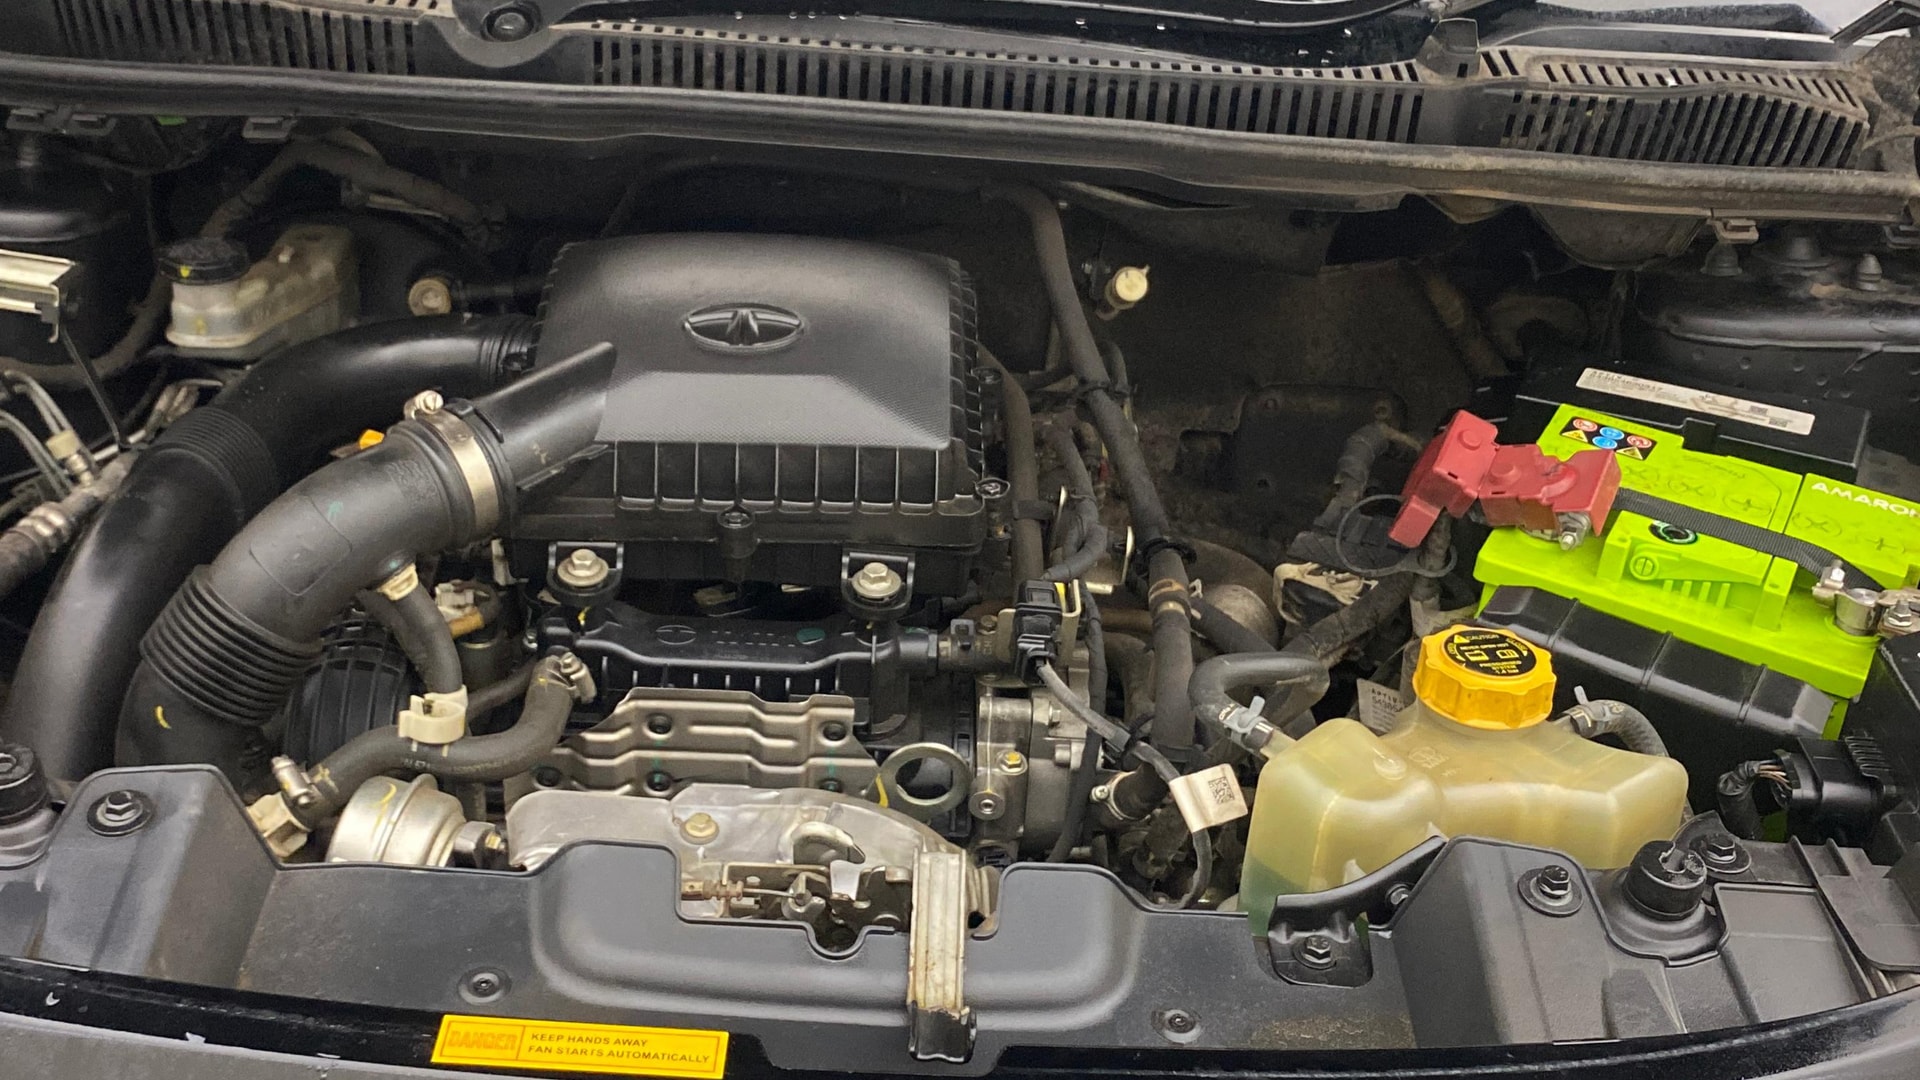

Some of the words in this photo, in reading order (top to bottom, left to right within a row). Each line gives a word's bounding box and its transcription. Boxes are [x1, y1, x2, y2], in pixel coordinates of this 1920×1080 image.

[447, 1030, 518, 1050] DANGER
[531, 1033, 564, 1042] KEEP
[567, 1034, 610, 1045] HANDS
[613, 1038, 648, 1047] AWAY
[528, 1046, 552, 1054] FAN
[556, 1046, 604, 1057] STARTS
[608, 1050, 710, 1064] AUTOMATICALLY
